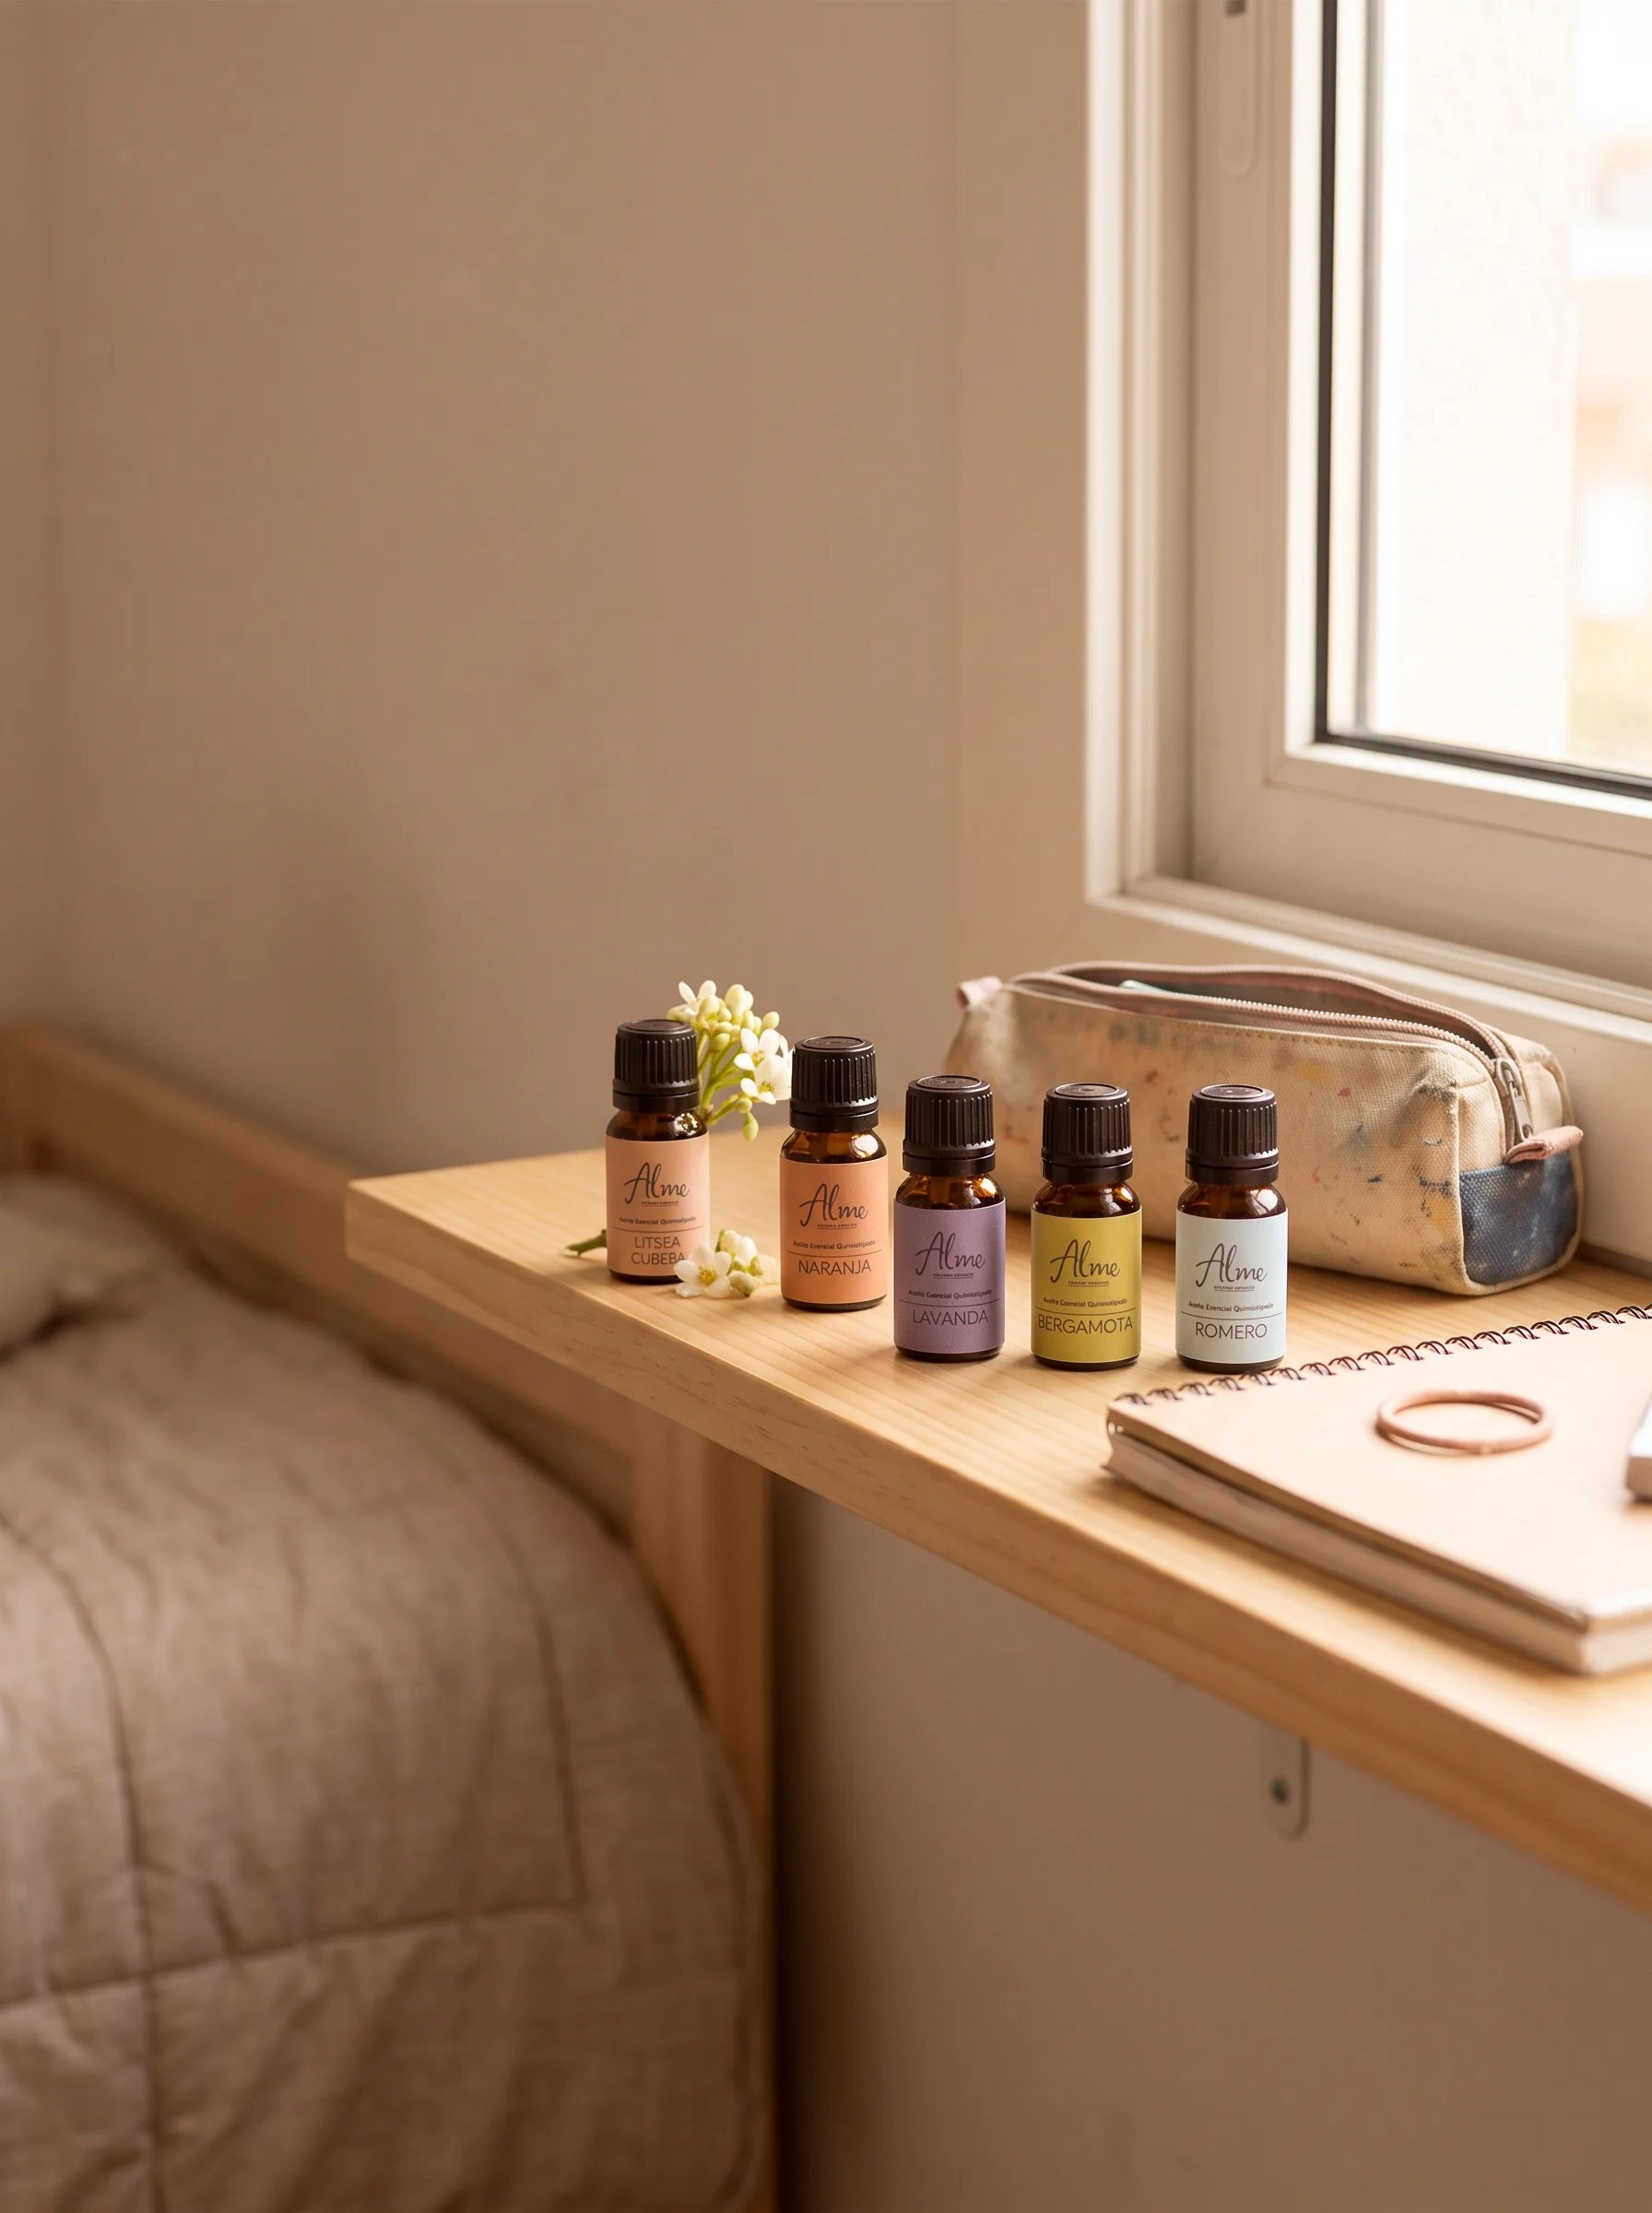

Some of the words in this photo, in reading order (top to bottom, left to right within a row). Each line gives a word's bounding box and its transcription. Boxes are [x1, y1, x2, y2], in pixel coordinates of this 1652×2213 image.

[623, 1162, 690, 1205] Alme
[798, 1183, 869, 1227] Alme
[634, 1236, 681, 1249] LITSEA
[631, 1251, 686, 1265] CUBEBA
[914, 1231, 986, 1276] Alme
[1049, 1238, 1122, 1284] Alme
[798, 1259, 872, 1276] NARANJA
[1195, 1242, 1268, 1288] Alme
[912, 1308, 990, 1326] LAVANDA
[1038, 1314, 1134, 1335] BERGAMOTA
[1195, 1321, 1268, 1340] ROMERO
